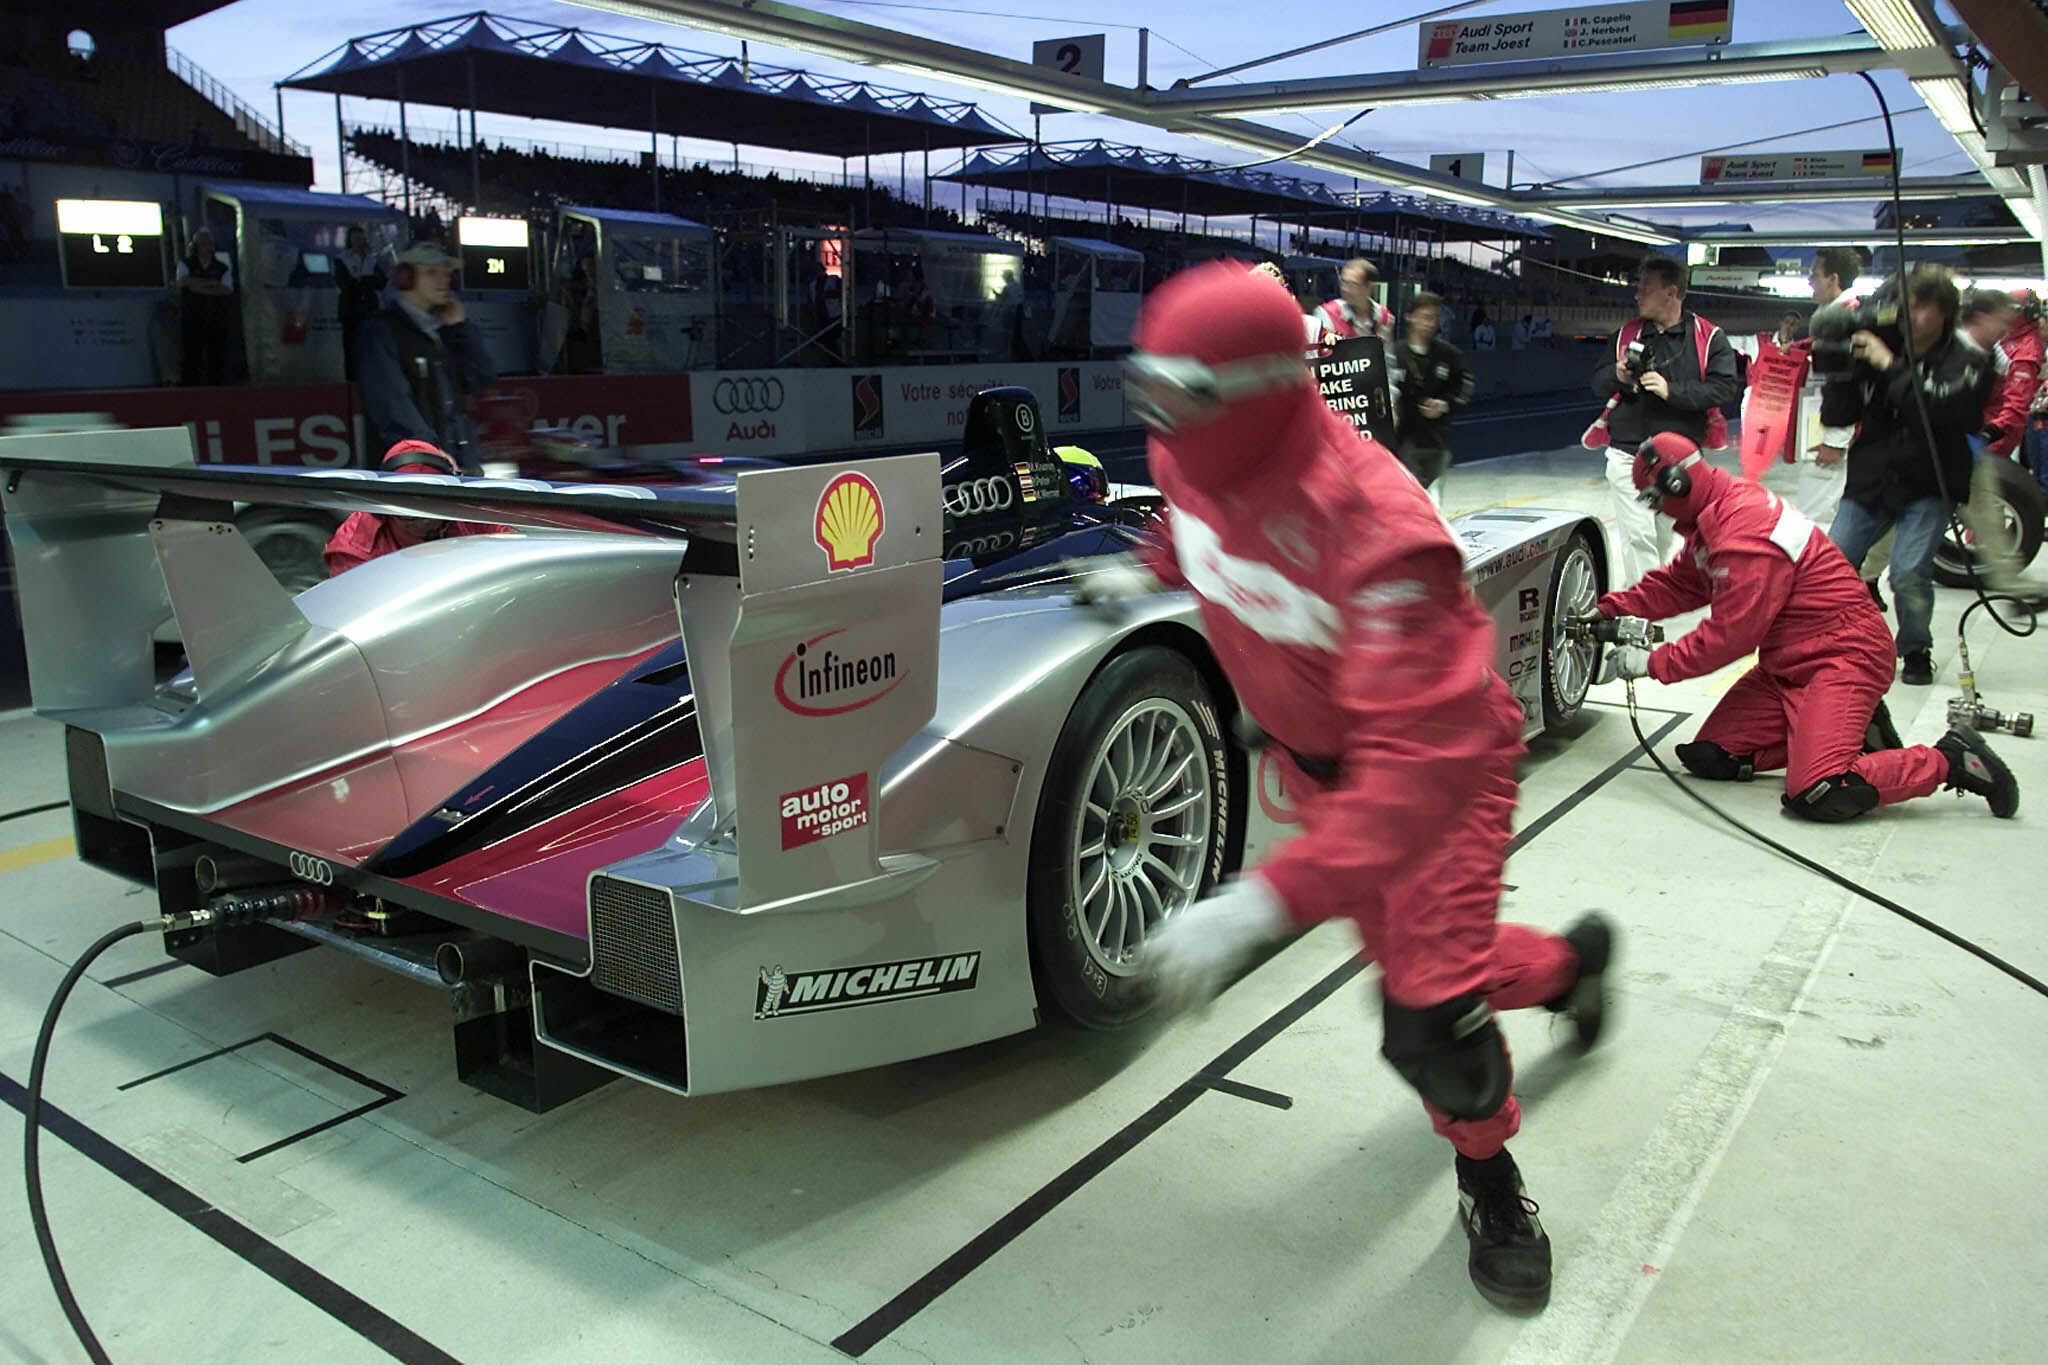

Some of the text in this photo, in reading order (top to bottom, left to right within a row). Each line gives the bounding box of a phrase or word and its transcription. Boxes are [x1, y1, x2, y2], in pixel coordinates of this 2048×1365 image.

[1459, 23, 1491, 39] Audi
[1494, 20, 1534, 38] Sport
[1580, 25, 1630, 36] J. Herbert
[1455, 36, 1531, 54] Team Joest
[1056, 43, 1081, 76] 2
[1448, 159, 1461, 178] 1
[92, 234, 110, 254] L
[1319, 358, 1372, 378] PUMP
[901, 382, 941, 403] Votre
[726, 419, 777, 442] Audi
[1518, 587, 1540, 611] R
[782, 782, 850, 819] auto
[797, 798, 862, 830] motor
[1211, 748, 1229, 884] MICHELIN
[788, 954, 979, 1004] MICHELIN
